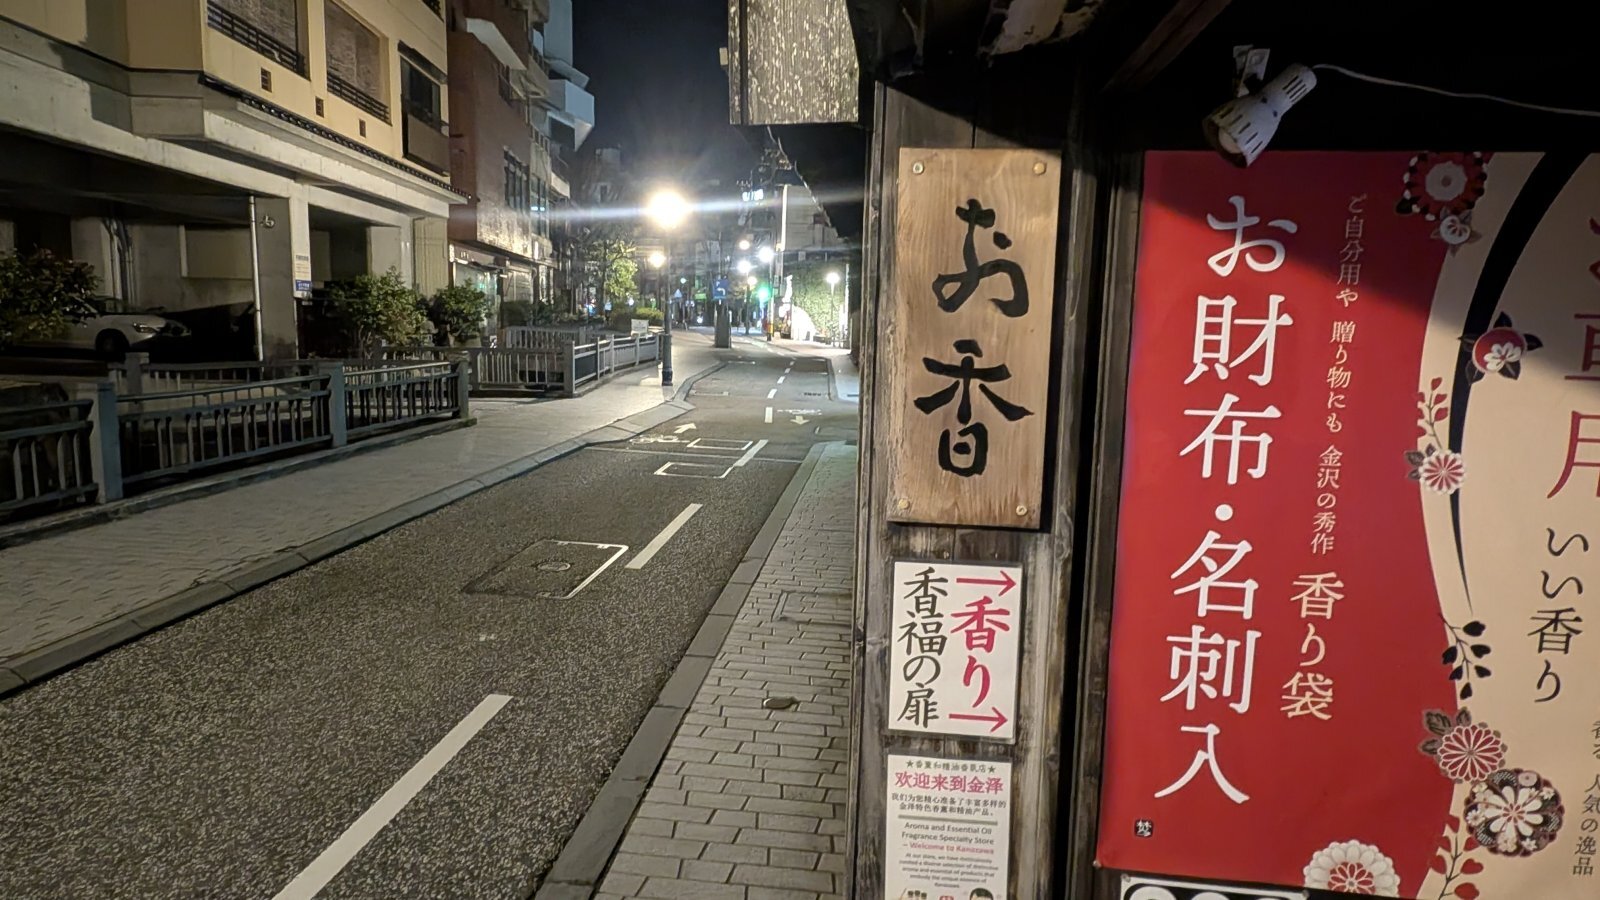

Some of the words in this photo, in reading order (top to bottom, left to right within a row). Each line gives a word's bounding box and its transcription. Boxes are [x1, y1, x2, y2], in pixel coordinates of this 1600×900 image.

[1336, 194, 1367, 308] ご自分用や
[913, 198, 1035, 478] お香
[1326, 321, 1357, 433] 贈り物にも
[1154, 195, 1298, 804] お財布・名刺入
[1310, 444, 1343, 555] 金沢の秀作
[897, 566, 949, 729] 香福の扉
[950, 595, 1011, 709] 香り
[1281, 571, 1345, 721] 香り袋
[1527, 527, 1590, 703] いい香り
[894, 771, 1004, 795] 欢迎来到金泽
[901, 831, 938, 841] Fragrance
[939, 834, 972, 844] Specialty
[974, 837, 994, 845] Store
[904, 822, 929, 831] Aroma
[947, 825, 979, 834] Essential
[981, 827, 992, 835] Oil
[910, 842, 945, 851] Welcome
